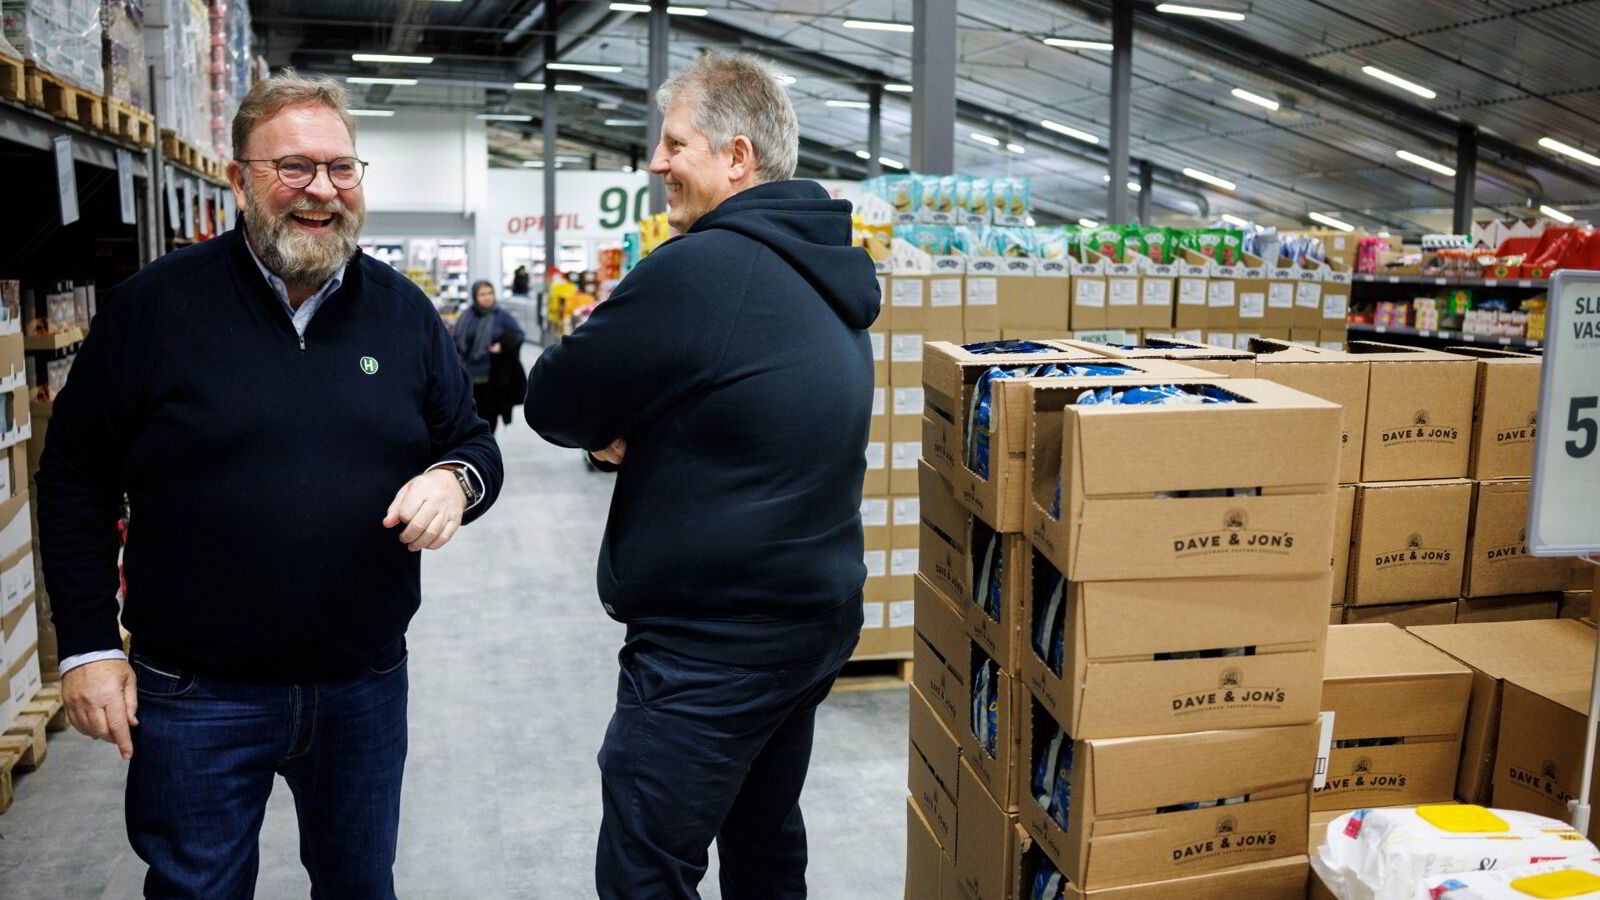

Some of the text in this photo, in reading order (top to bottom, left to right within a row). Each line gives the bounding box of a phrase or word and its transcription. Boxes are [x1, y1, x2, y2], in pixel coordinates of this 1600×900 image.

[1382, 430, 1412, 442] DAVE
[1416, 428, 1425, 438] &
[1428, 427, 1458, 440] JON'S
[1496, 430, 1526, 442] DAVE
[1564, 396, 1598, 459] 5
[1173, 535, 1221, 552] DAVE
[1228, 533, 1240, 545] &
[1247, 531, 1294, 548] JON'S
[1375, 553, 1405, 566] DAVE
[1409, 551, 1417, 560] &
[1421, 549, 1451, 561] JON'S
[1488, 547, 1517, 559] DAVE
[1172, 693, 1217, 710] DAVE
[1224, 690, 1235, 702] &
[1241, 687, 1286, 703] JON'S
[1355, 776, 1365, 786] &
[1370, 774, 1407, 787] JON'S
[1509, 767, 1540, 788] DAVE
[1544, 782, 1553, 794] &
[1172, 841, 1214, 860] DAVE
[1220, 837, 1231, 849] &
[1236, 830, 1277, 847] JON'S
